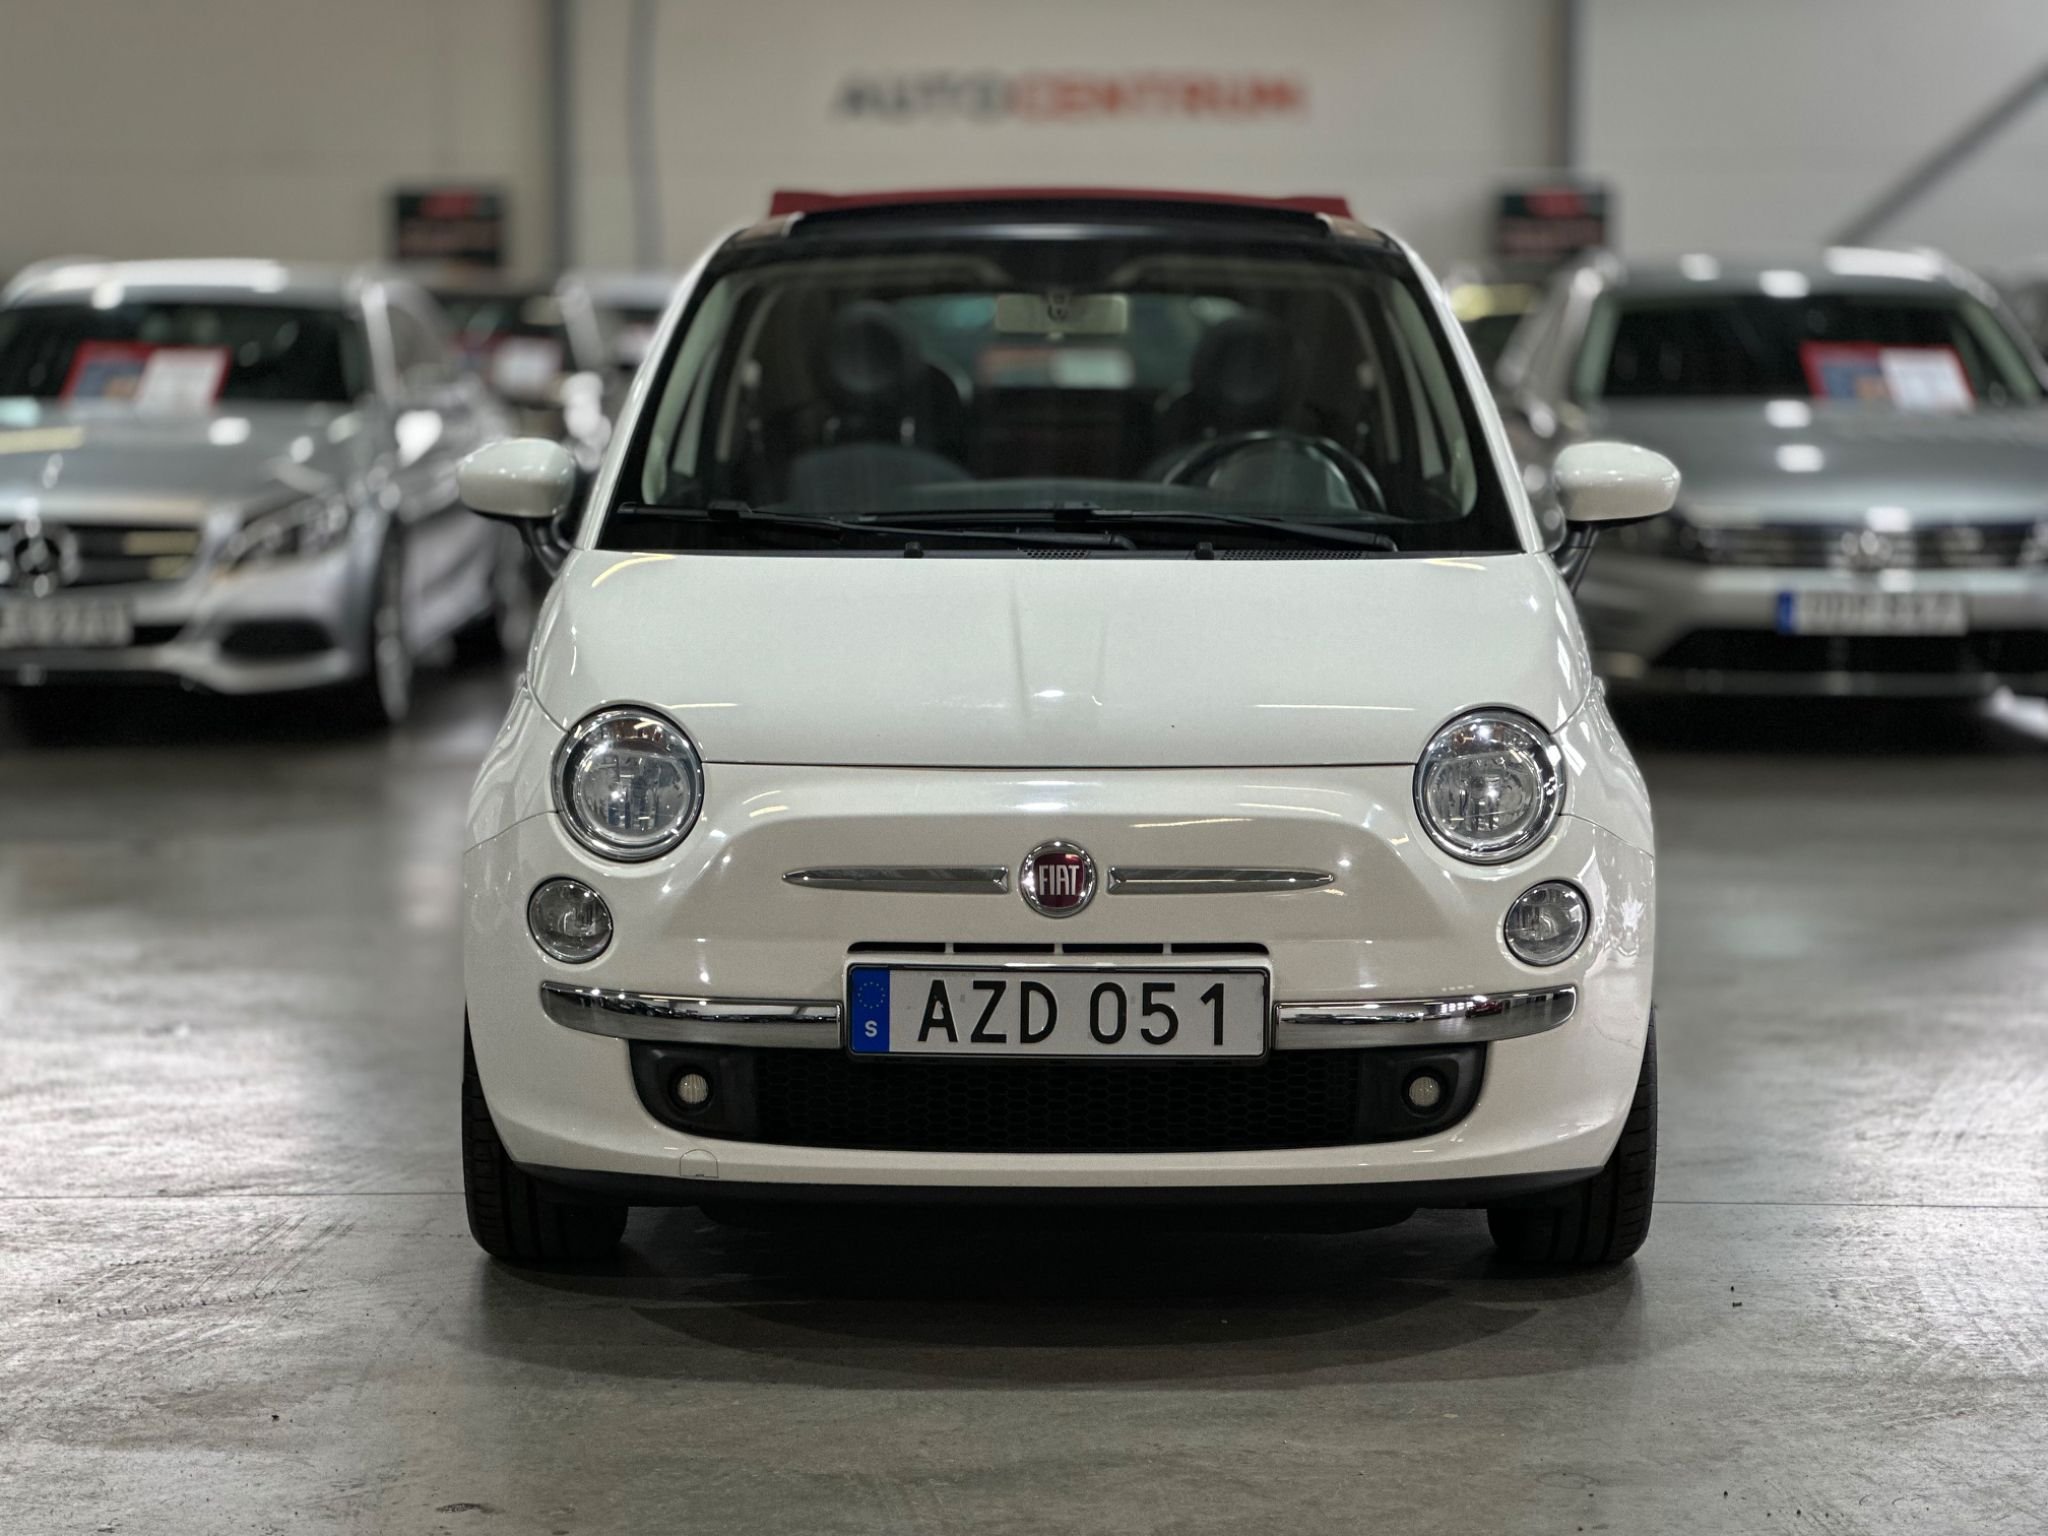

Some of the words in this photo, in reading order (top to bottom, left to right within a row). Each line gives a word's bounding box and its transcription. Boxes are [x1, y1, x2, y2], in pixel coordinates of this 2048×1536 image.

[835, 74, 1307, 121] AUTOCENTRUM
[1039, 864, 1079, 896] FIAT
[864, 1020, 878, 1038] S
[917, 979, 1058, 1044] AZD
[1088, 981, 1225, 1046] 051
